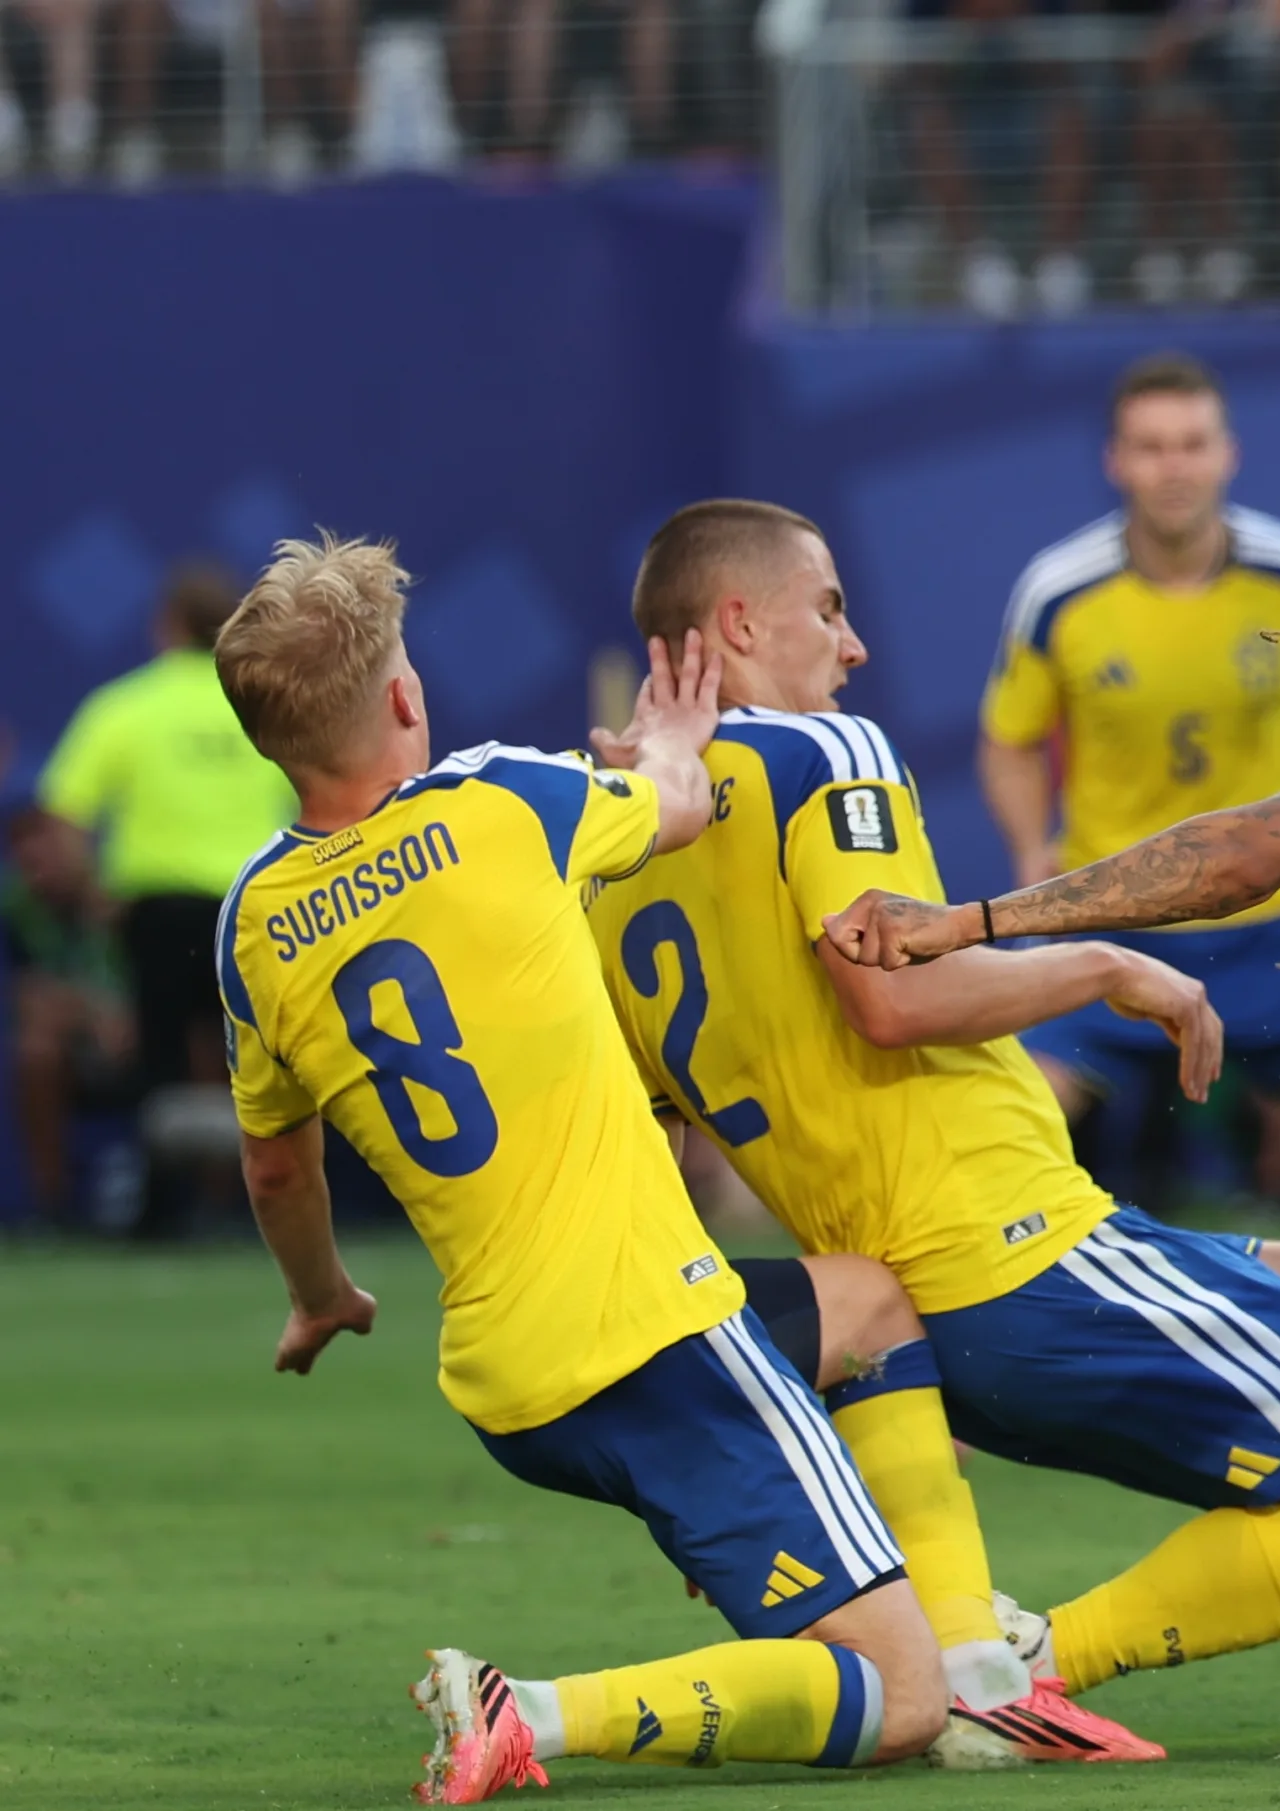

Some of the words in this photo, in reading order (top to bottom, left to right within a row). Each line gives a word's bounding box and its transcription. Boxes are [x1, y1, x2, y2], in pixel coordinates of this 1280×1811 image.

[266, 822, 460, 963] SVENSSON
[312, 827, 365, 867] SVERIGE
[331, 938, 499, 1179] 8
[621, 899, 770, 1148] 2
